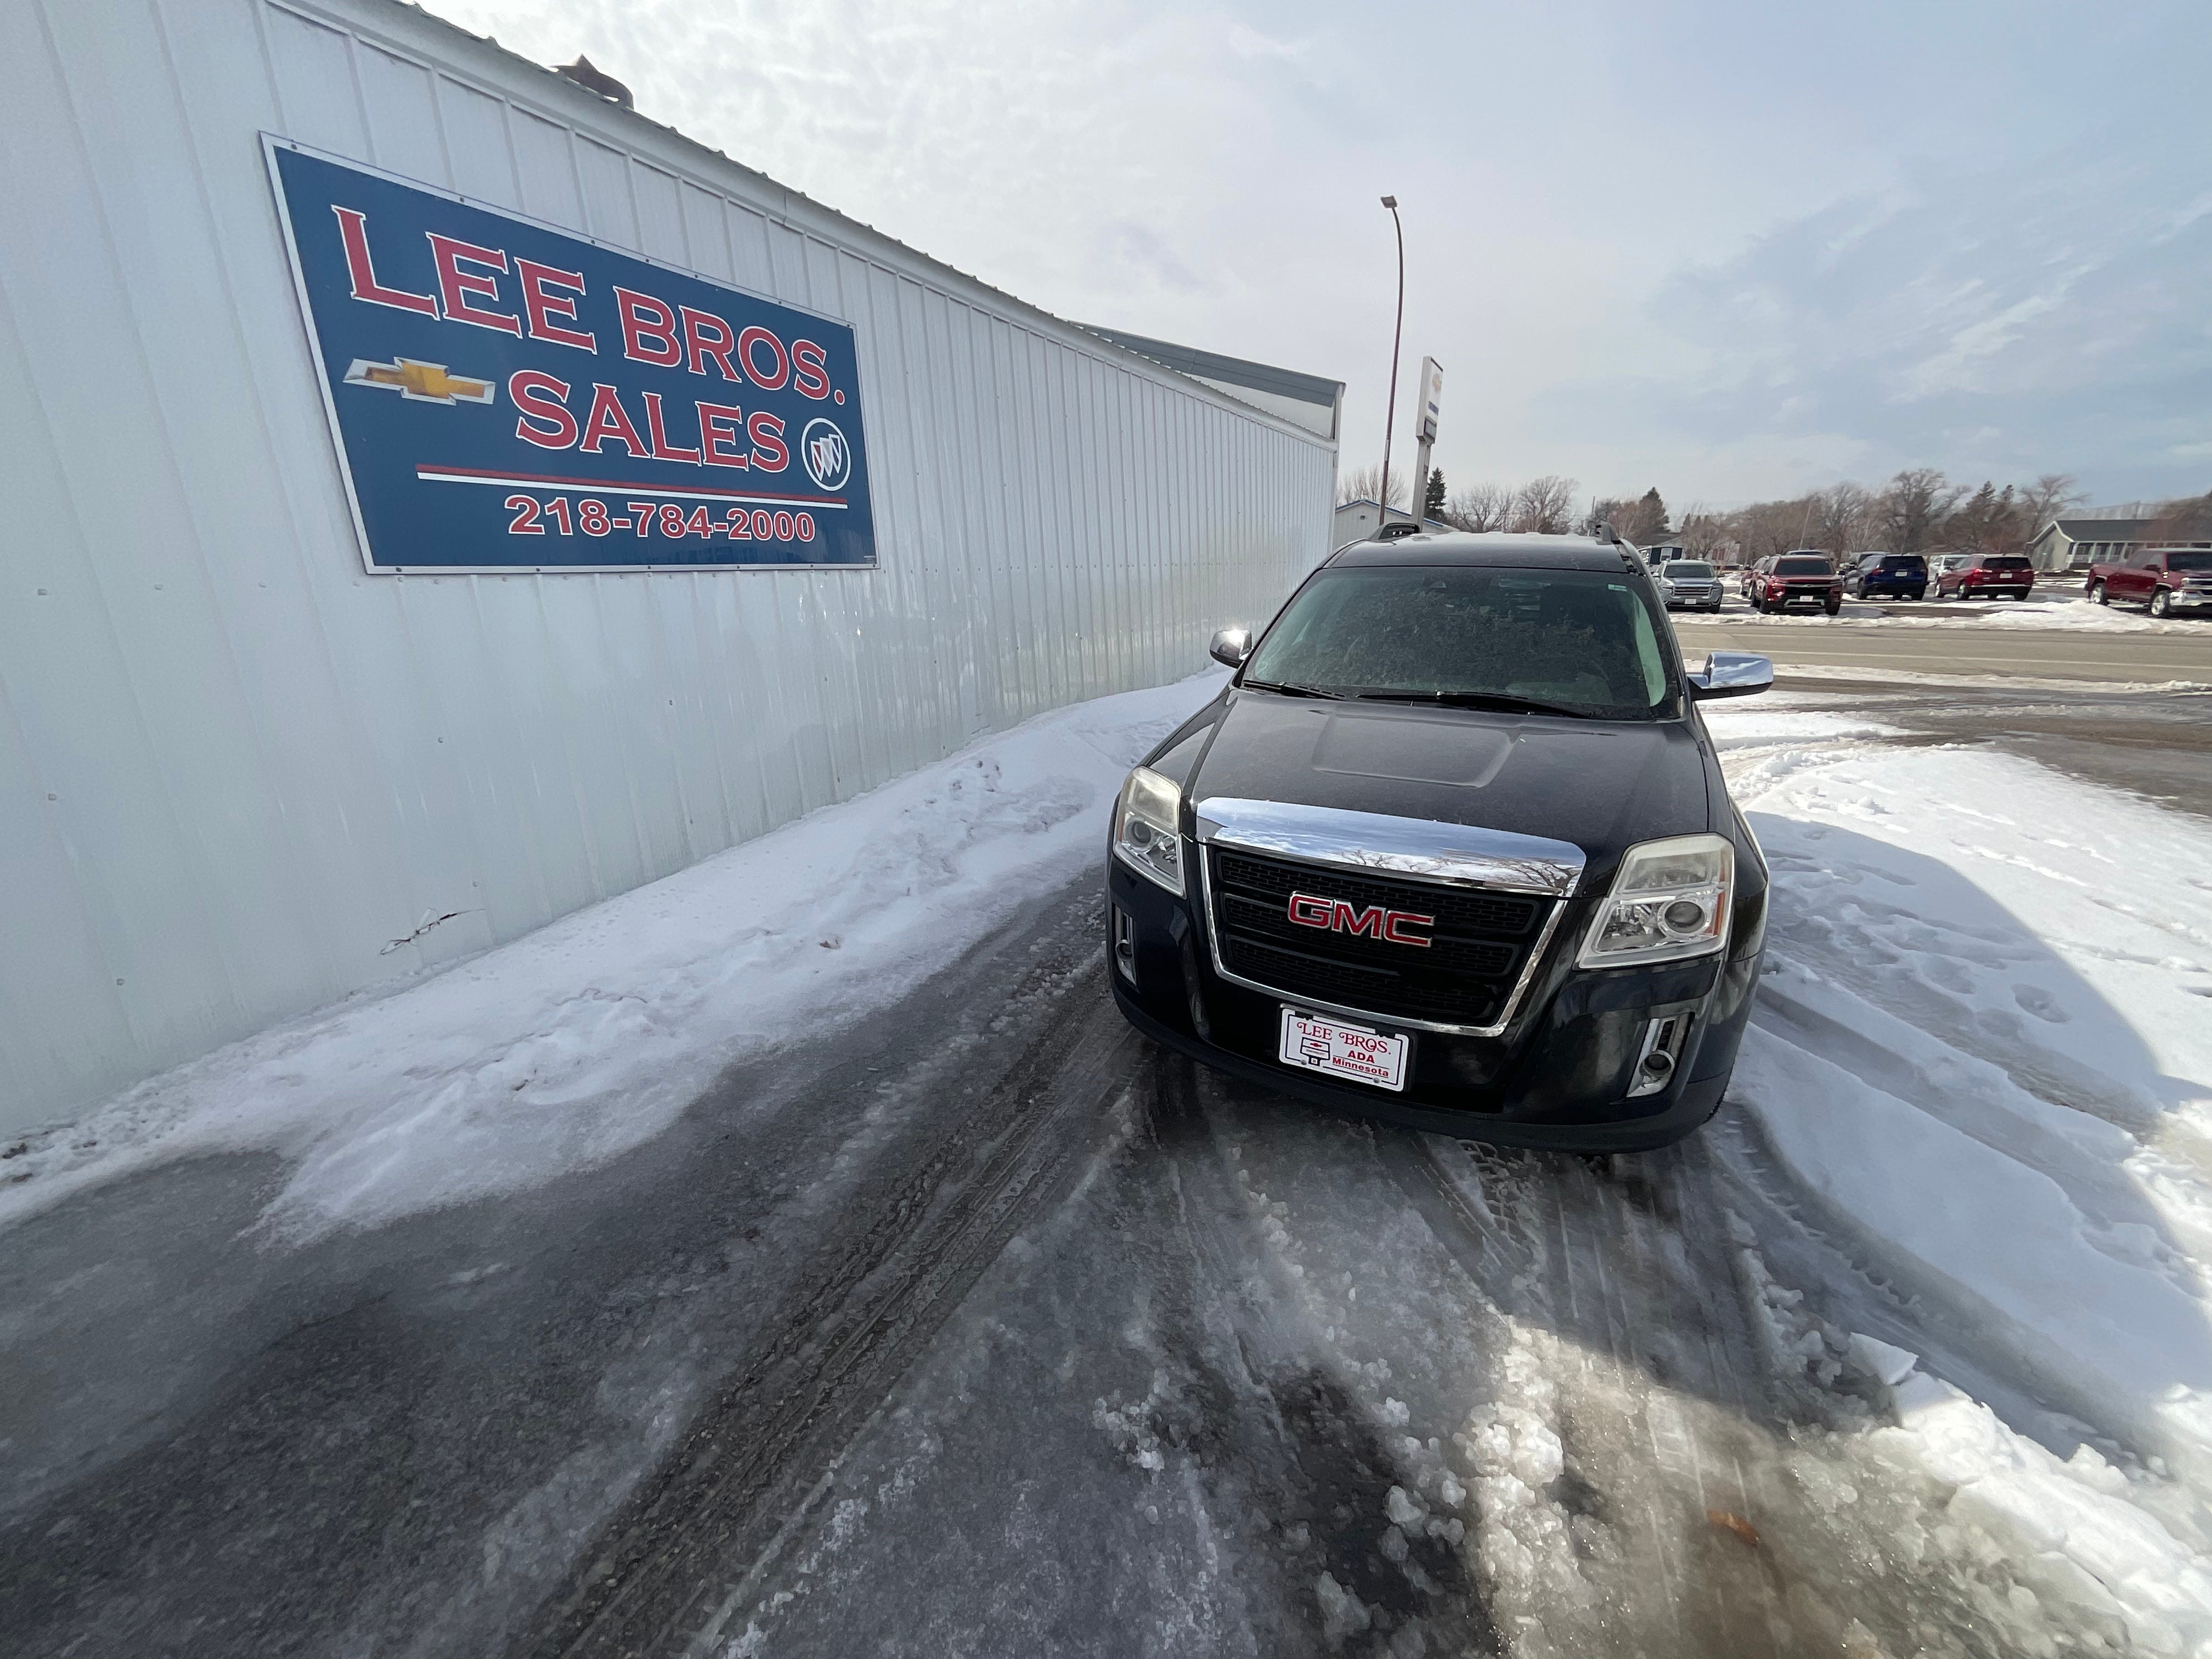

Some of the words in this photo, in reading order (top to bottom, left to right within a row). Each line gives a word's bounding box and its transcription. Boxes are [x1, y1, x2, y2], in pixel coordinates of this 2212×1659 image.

[330, 204, 597, 355] LEE
[612, 285, 846, 405] BROS.
[508, 369, 790, 473] SALES
[504, 494, 815, 543] 218-784-2000
[1288, 891, 1436, 947] GMC
[1297, 1022, 1332, 1040] LEE
[1339, 1032, 1391, 1055] BROS.
[1347, 1050, 1375, 1063] ADA
[1333, 1057, 1389, 1076] Minnesota
